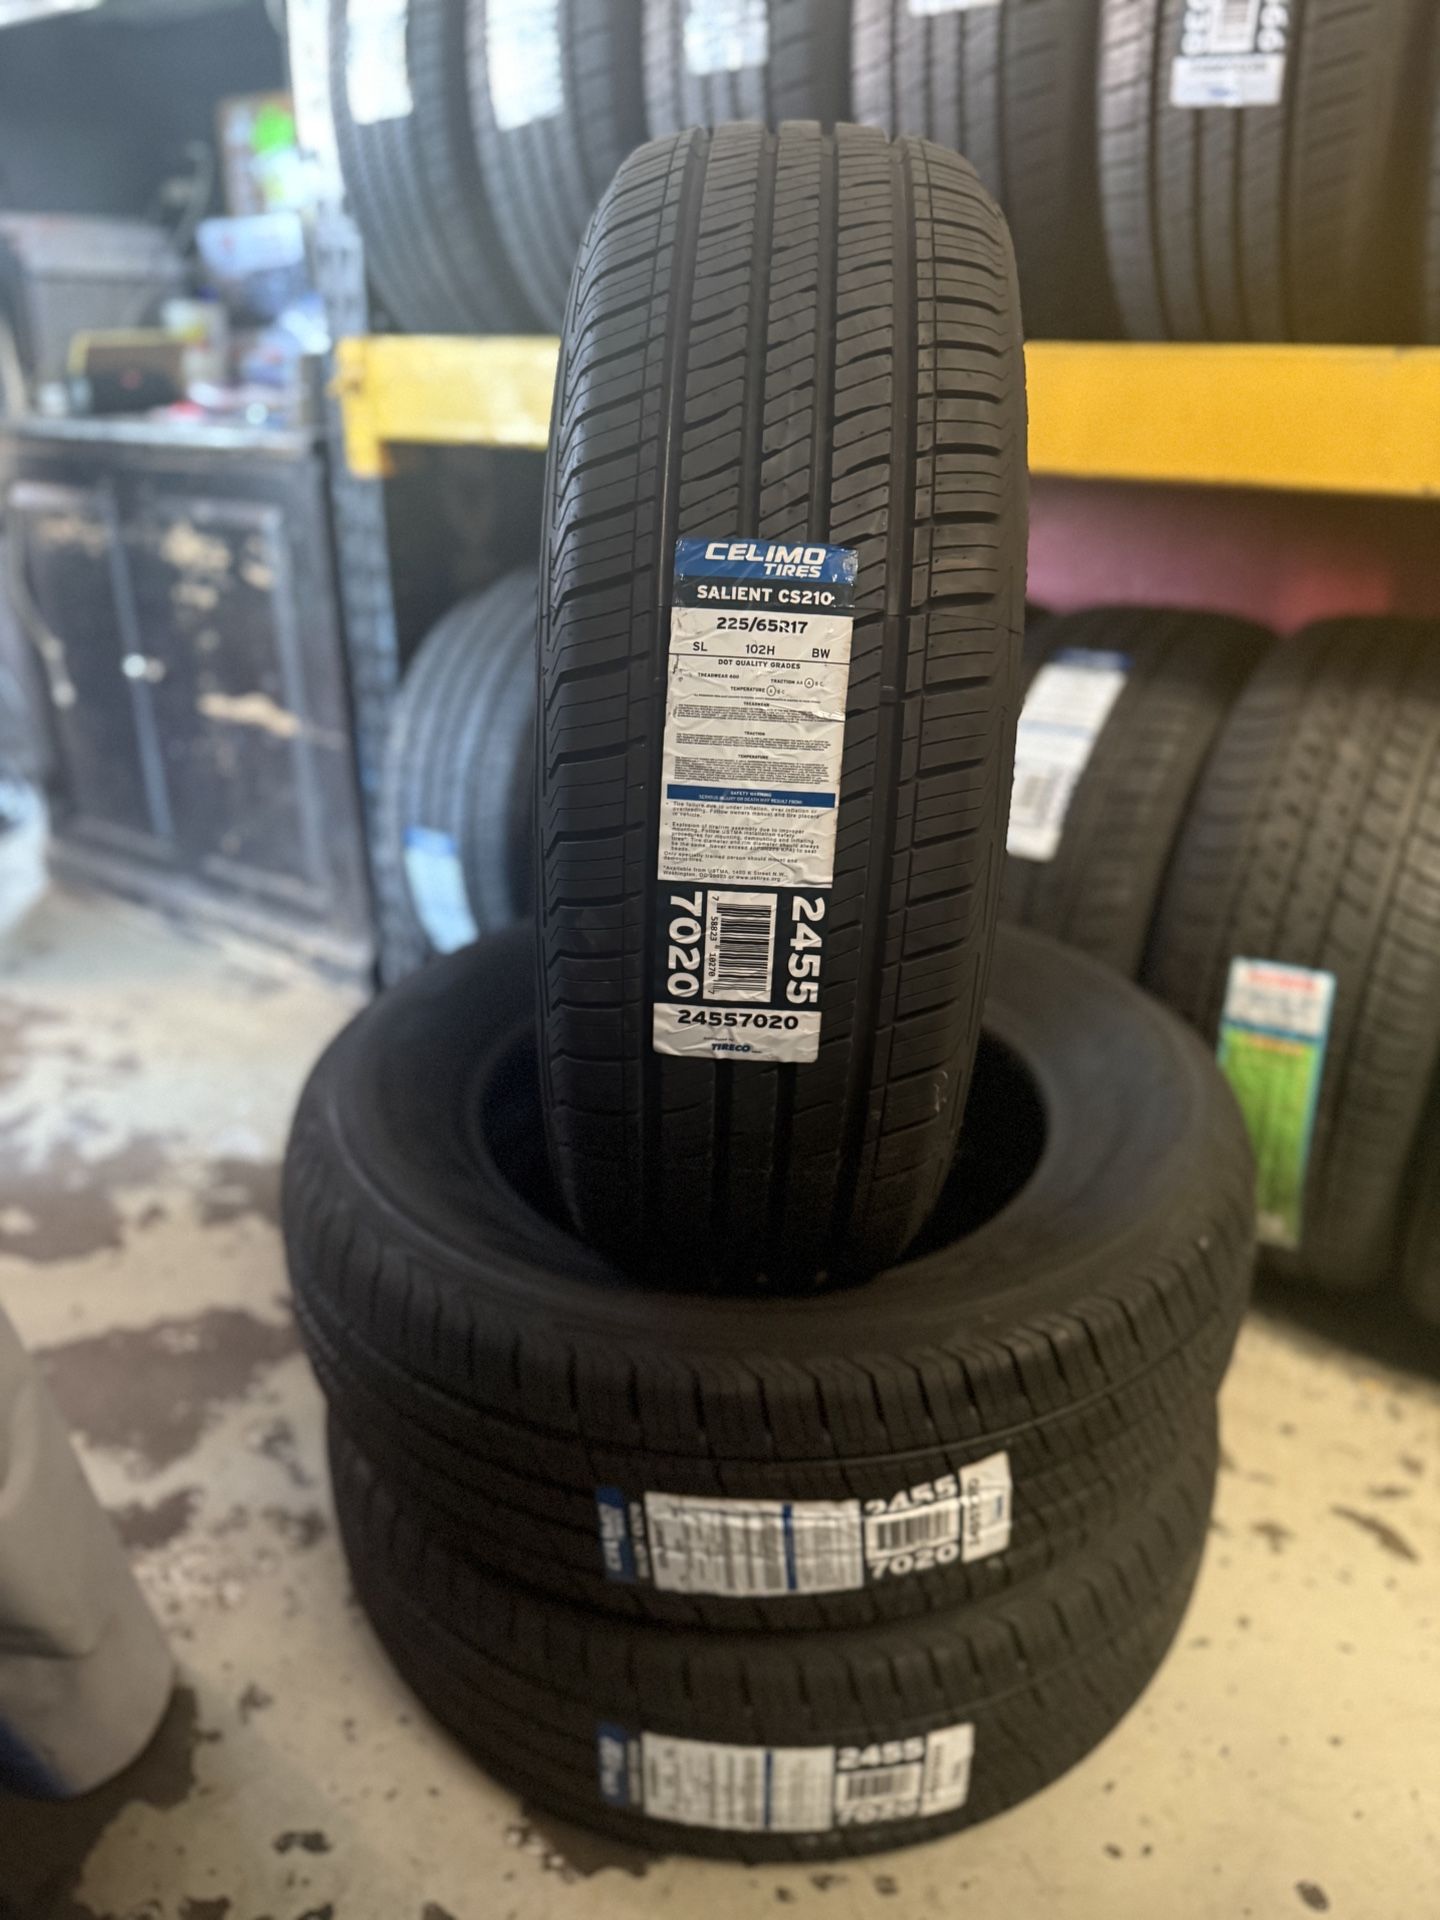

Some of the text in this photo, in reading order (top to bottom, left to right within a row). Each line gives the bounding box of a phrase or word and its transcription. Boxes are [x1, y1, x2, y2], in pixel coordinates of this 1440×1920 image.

[704, 542, 826, 565] CELIMO
[762, 563, 822, 578] TIRES
[697, 585, 833, 606] SALIENT CS210
[716, 617, 808, 634] 225/65R17
[692, 641, 831, 659] SL 102H BW
[710, 916, 719, 942] 58823
[667, 891, 703, 998] 7020
[786, 895, 826, 1004] 2455
[708, 952, 717, 977] 10270
[677, 1009, 799, 1030] 24557020
[711, 1043, 751, 1052] TIRECO
[871, 1543, 959, 1580] 7020
